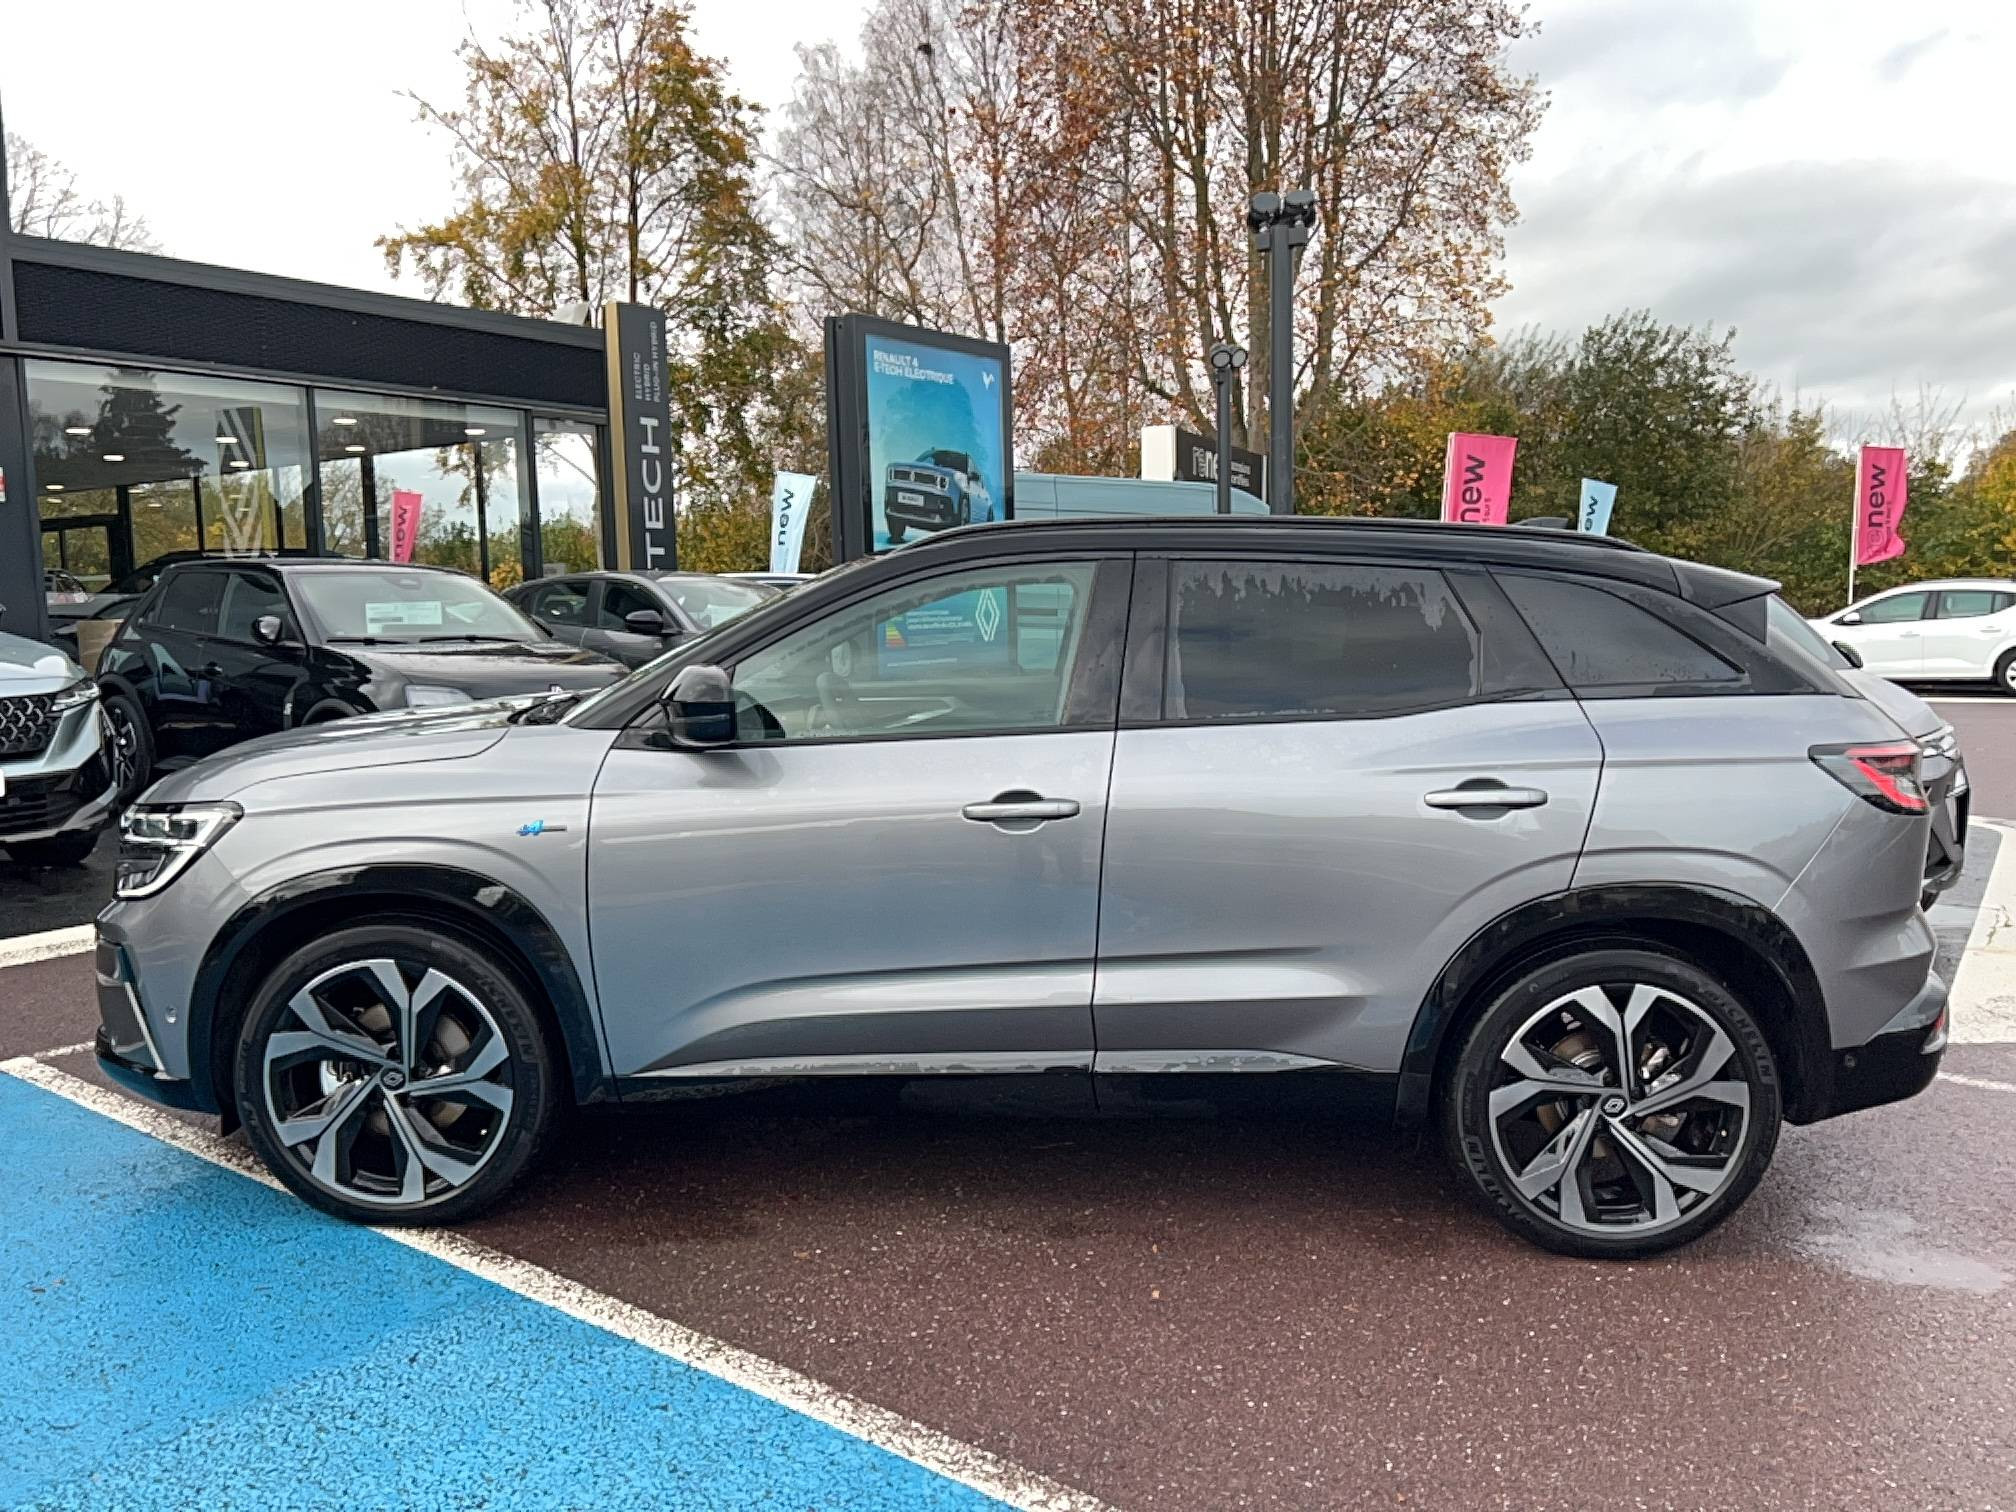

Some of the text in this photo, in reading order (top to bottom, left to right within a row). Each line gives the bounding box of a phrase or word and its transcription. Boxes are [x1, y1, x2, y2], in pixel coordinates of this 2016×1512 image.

[649, 321, 659, 359] HYBRID
[873, 349, 912, 366] RENAULT
[633, 351, 643, 400] ELECTRIC
[643, 363, 652, 401] HYBRID
[777, 488, 794, 546] new
